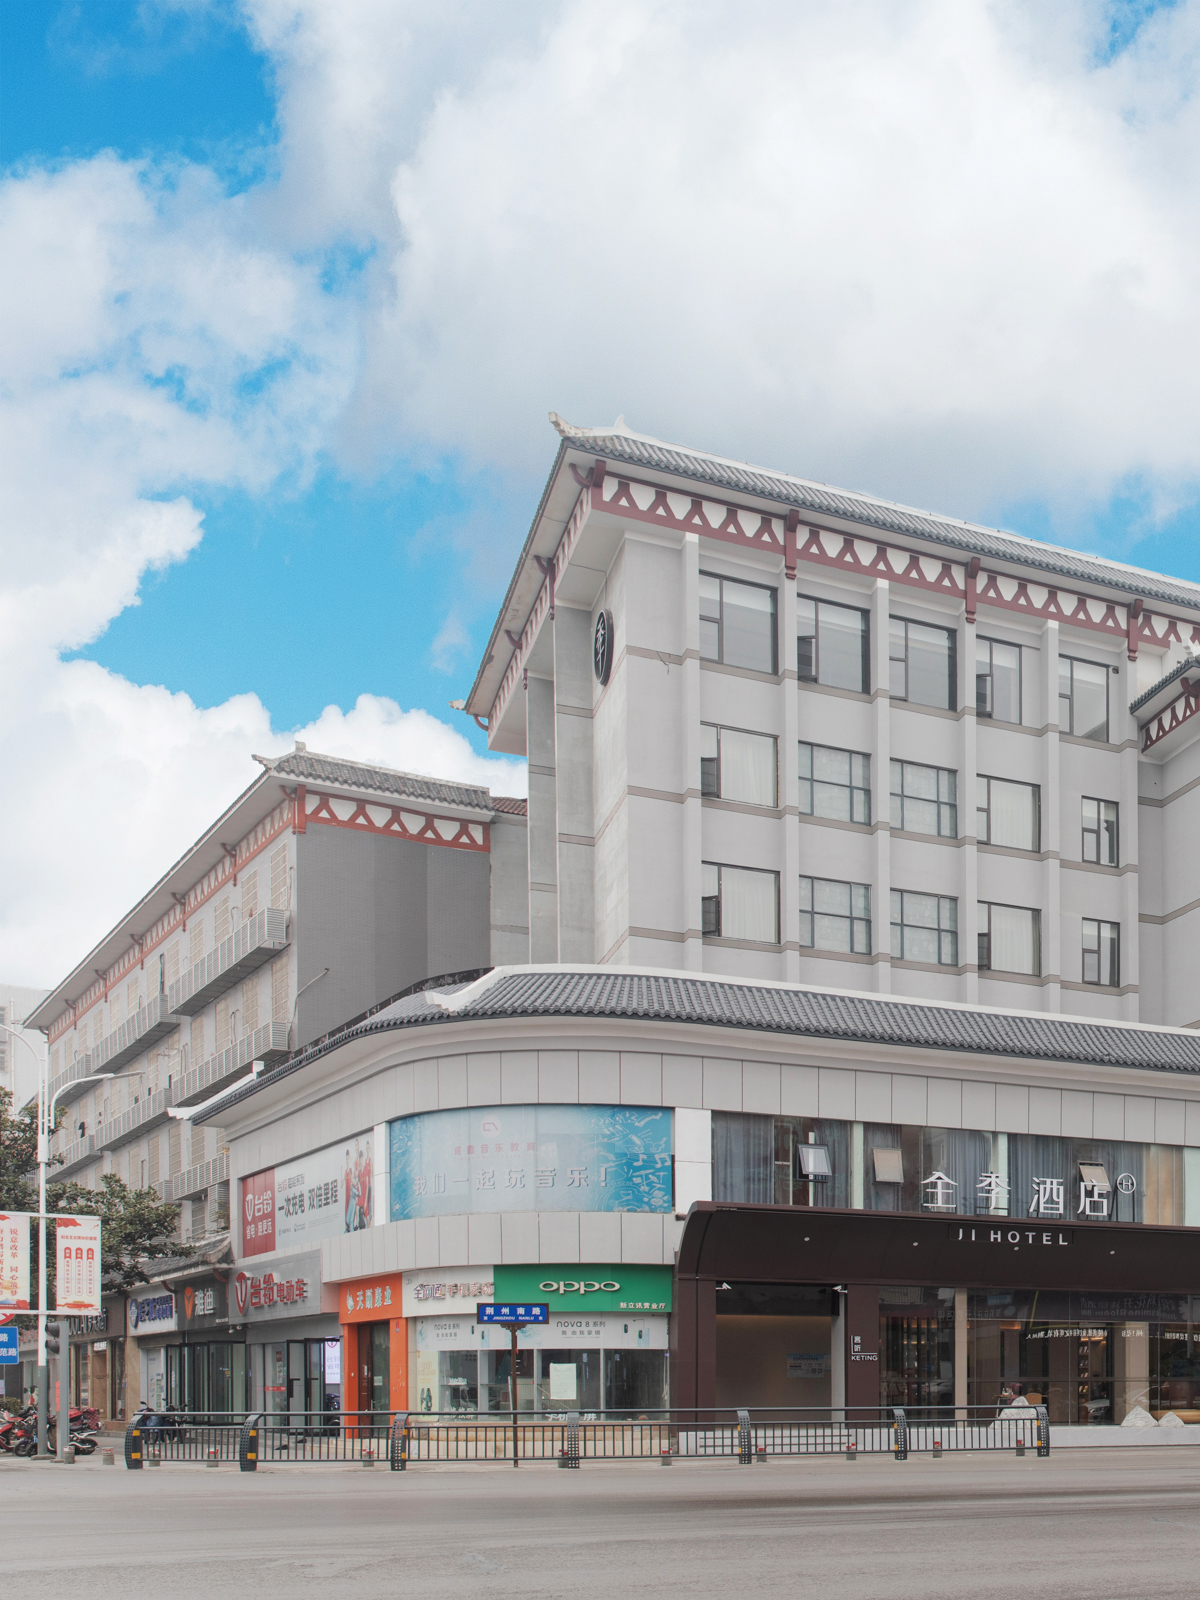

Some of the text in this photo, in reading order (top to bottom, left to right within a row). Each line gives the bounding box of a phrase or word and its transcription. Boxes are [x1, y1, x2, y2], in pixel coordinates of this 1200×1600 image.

[412, 1166, 608, 1197] 我们一起玩音乐！
[921, 1171, 1109, 1216] 全季酒店
[255, 1190, 273, 1217] 台铃
[278, 1179, 339, 1218] 一次充电 双倍里程
[958, 1228, 1068, 1245] JI HOTEL
[195, 1287, 214, 1315] 雅迪
[251, 1273, 305, 1308] 台铃 电动车
[485, 1307, 541, 1315] 荆州南路
